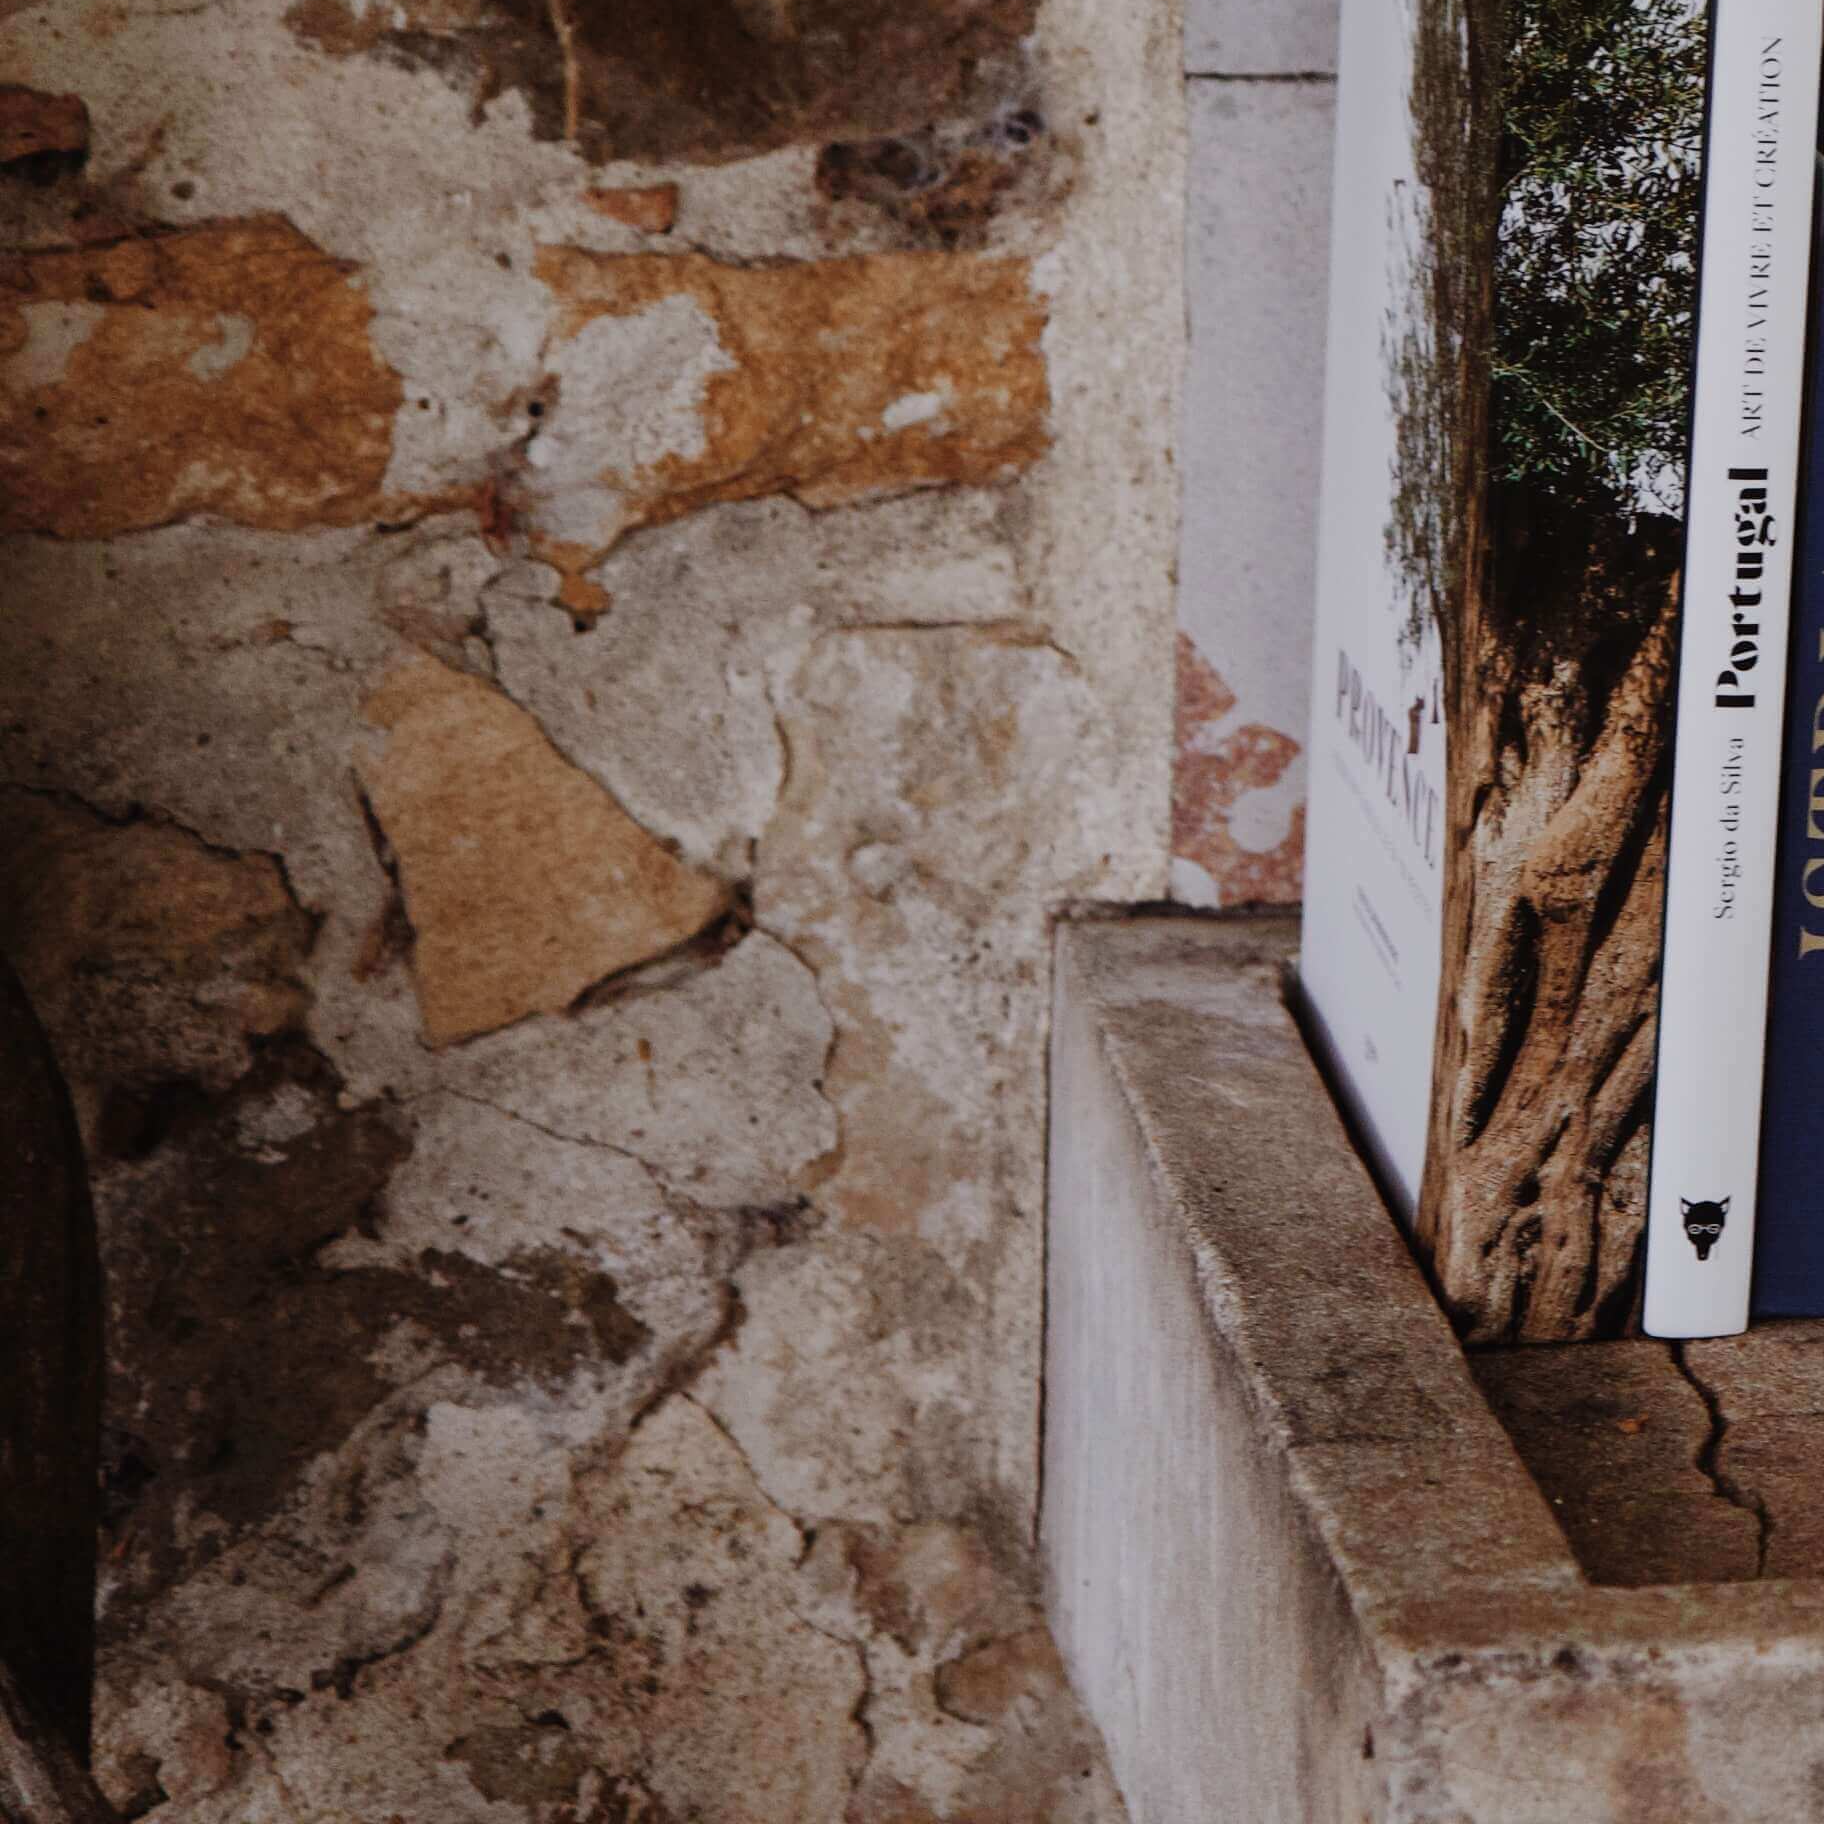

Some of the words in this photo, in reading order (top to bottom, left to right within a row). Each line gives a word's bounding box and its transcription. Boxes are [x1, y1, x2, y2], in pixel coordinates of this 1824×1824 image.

[1752, 37, 1782, 188] CRÉATION
[1752, 196, 1774, 232] ET
[1747, 244, 1772, 328] VIVRE
[1744, 338, 1767, 375] DE
[1741, 383, 1763, 439] ART
[1715, 468, 1777, 708] Portugal
[1720, 737, 1744, 795] Silva
[1719, 798, 1741, 832] da
[1714, 841, 1742, 920] Sergio
